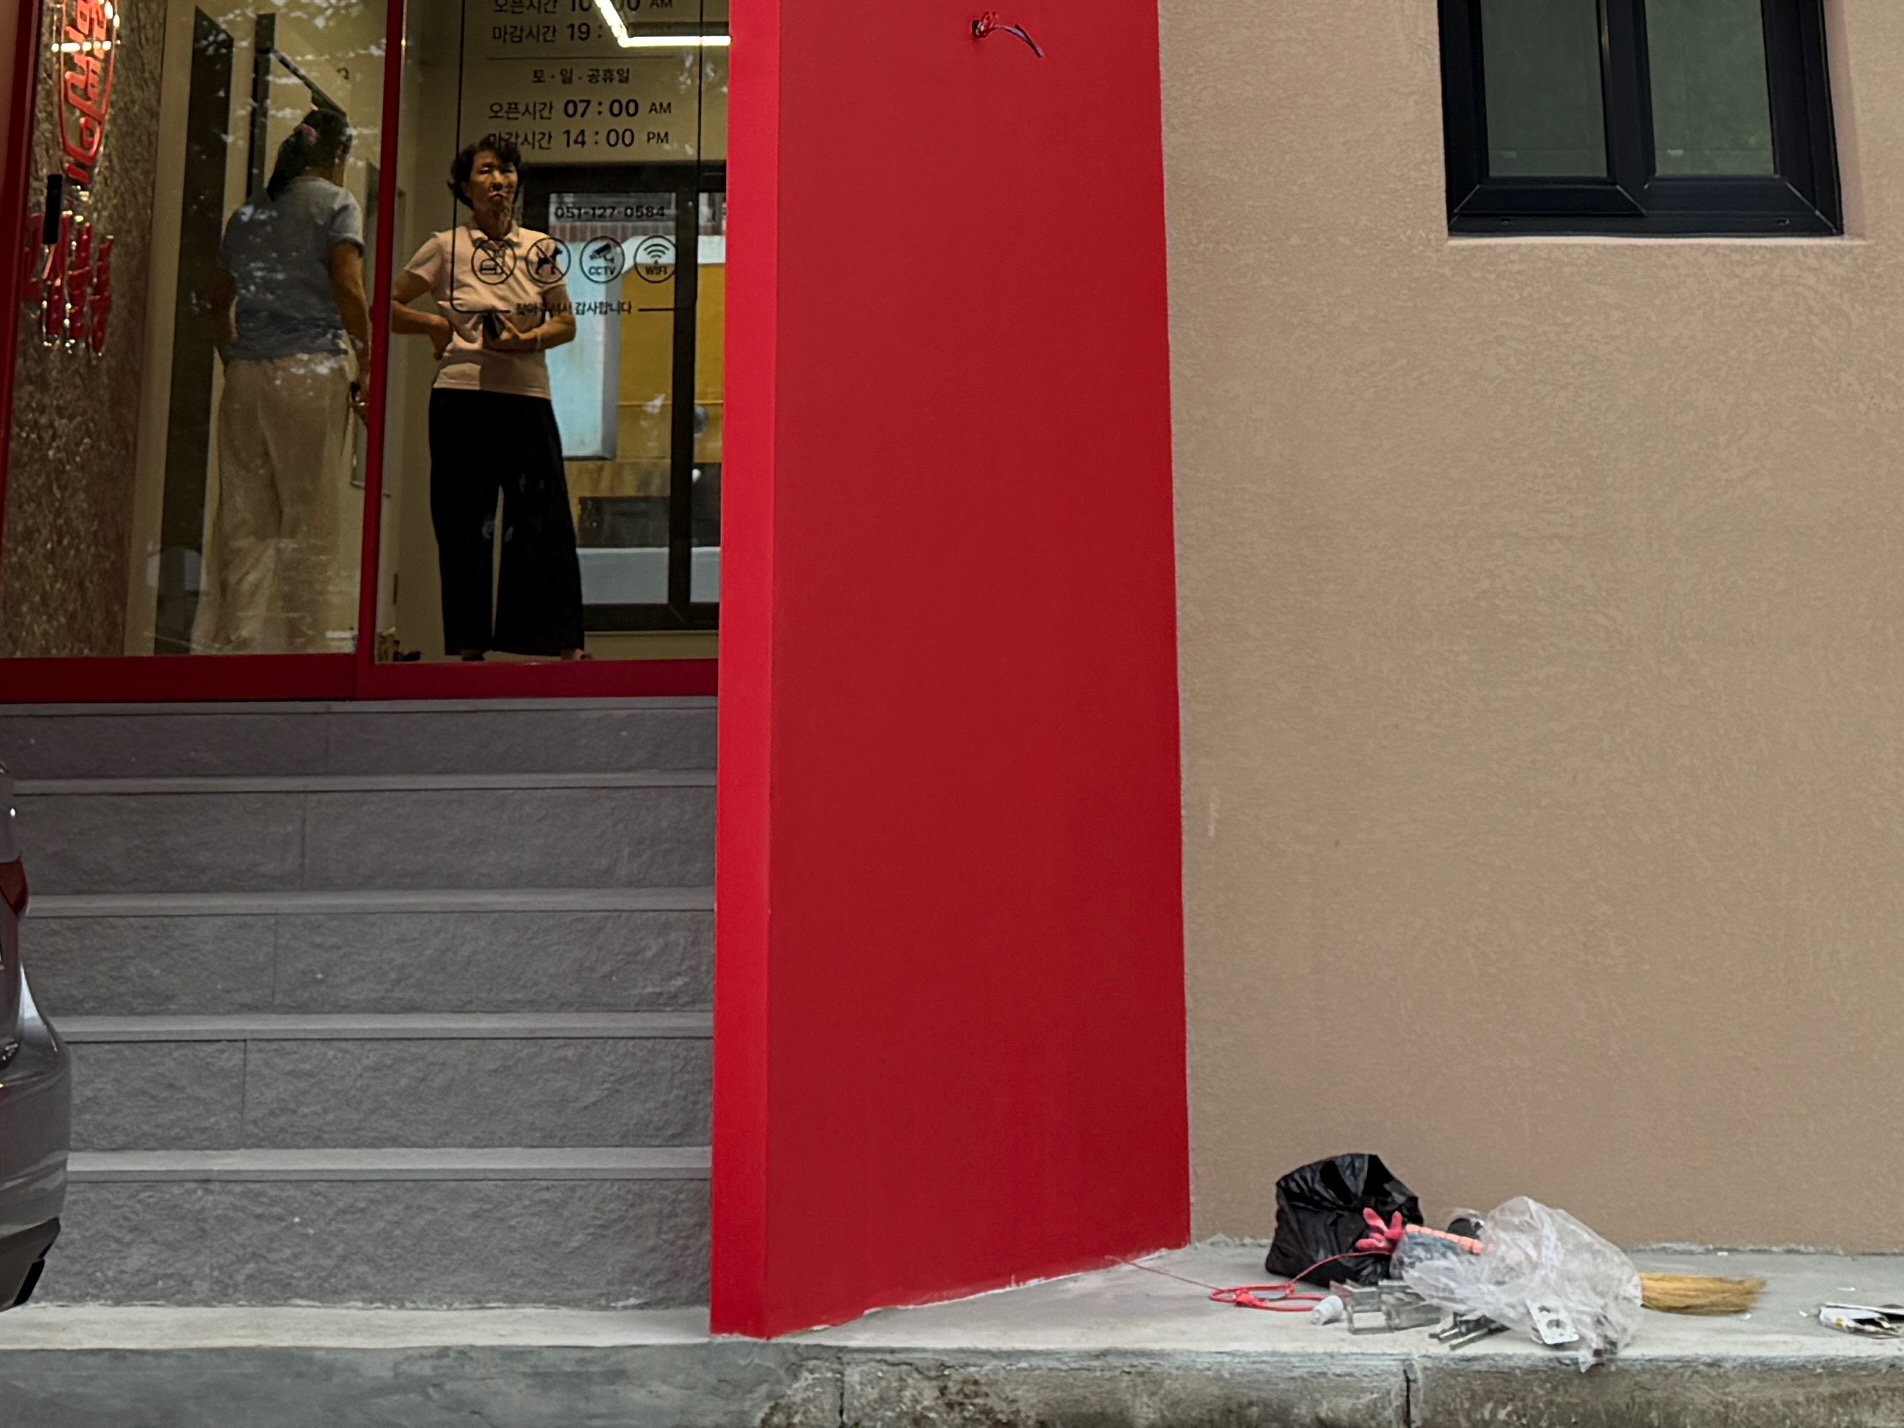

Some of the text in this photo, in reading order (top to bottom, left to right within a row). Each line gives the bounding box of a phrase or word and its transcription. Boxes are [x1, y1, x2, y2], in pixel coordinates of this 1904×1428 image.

[492, 24, 558, 44] 마감시간
[488, 101, 553, 120] 오픈시간
[648, 102, 672, 114] AM
[647, 131, 669, 144] PM
[588, 265, 616, 276] CCTV
[575, 300, 633, 315] 감사합니다
